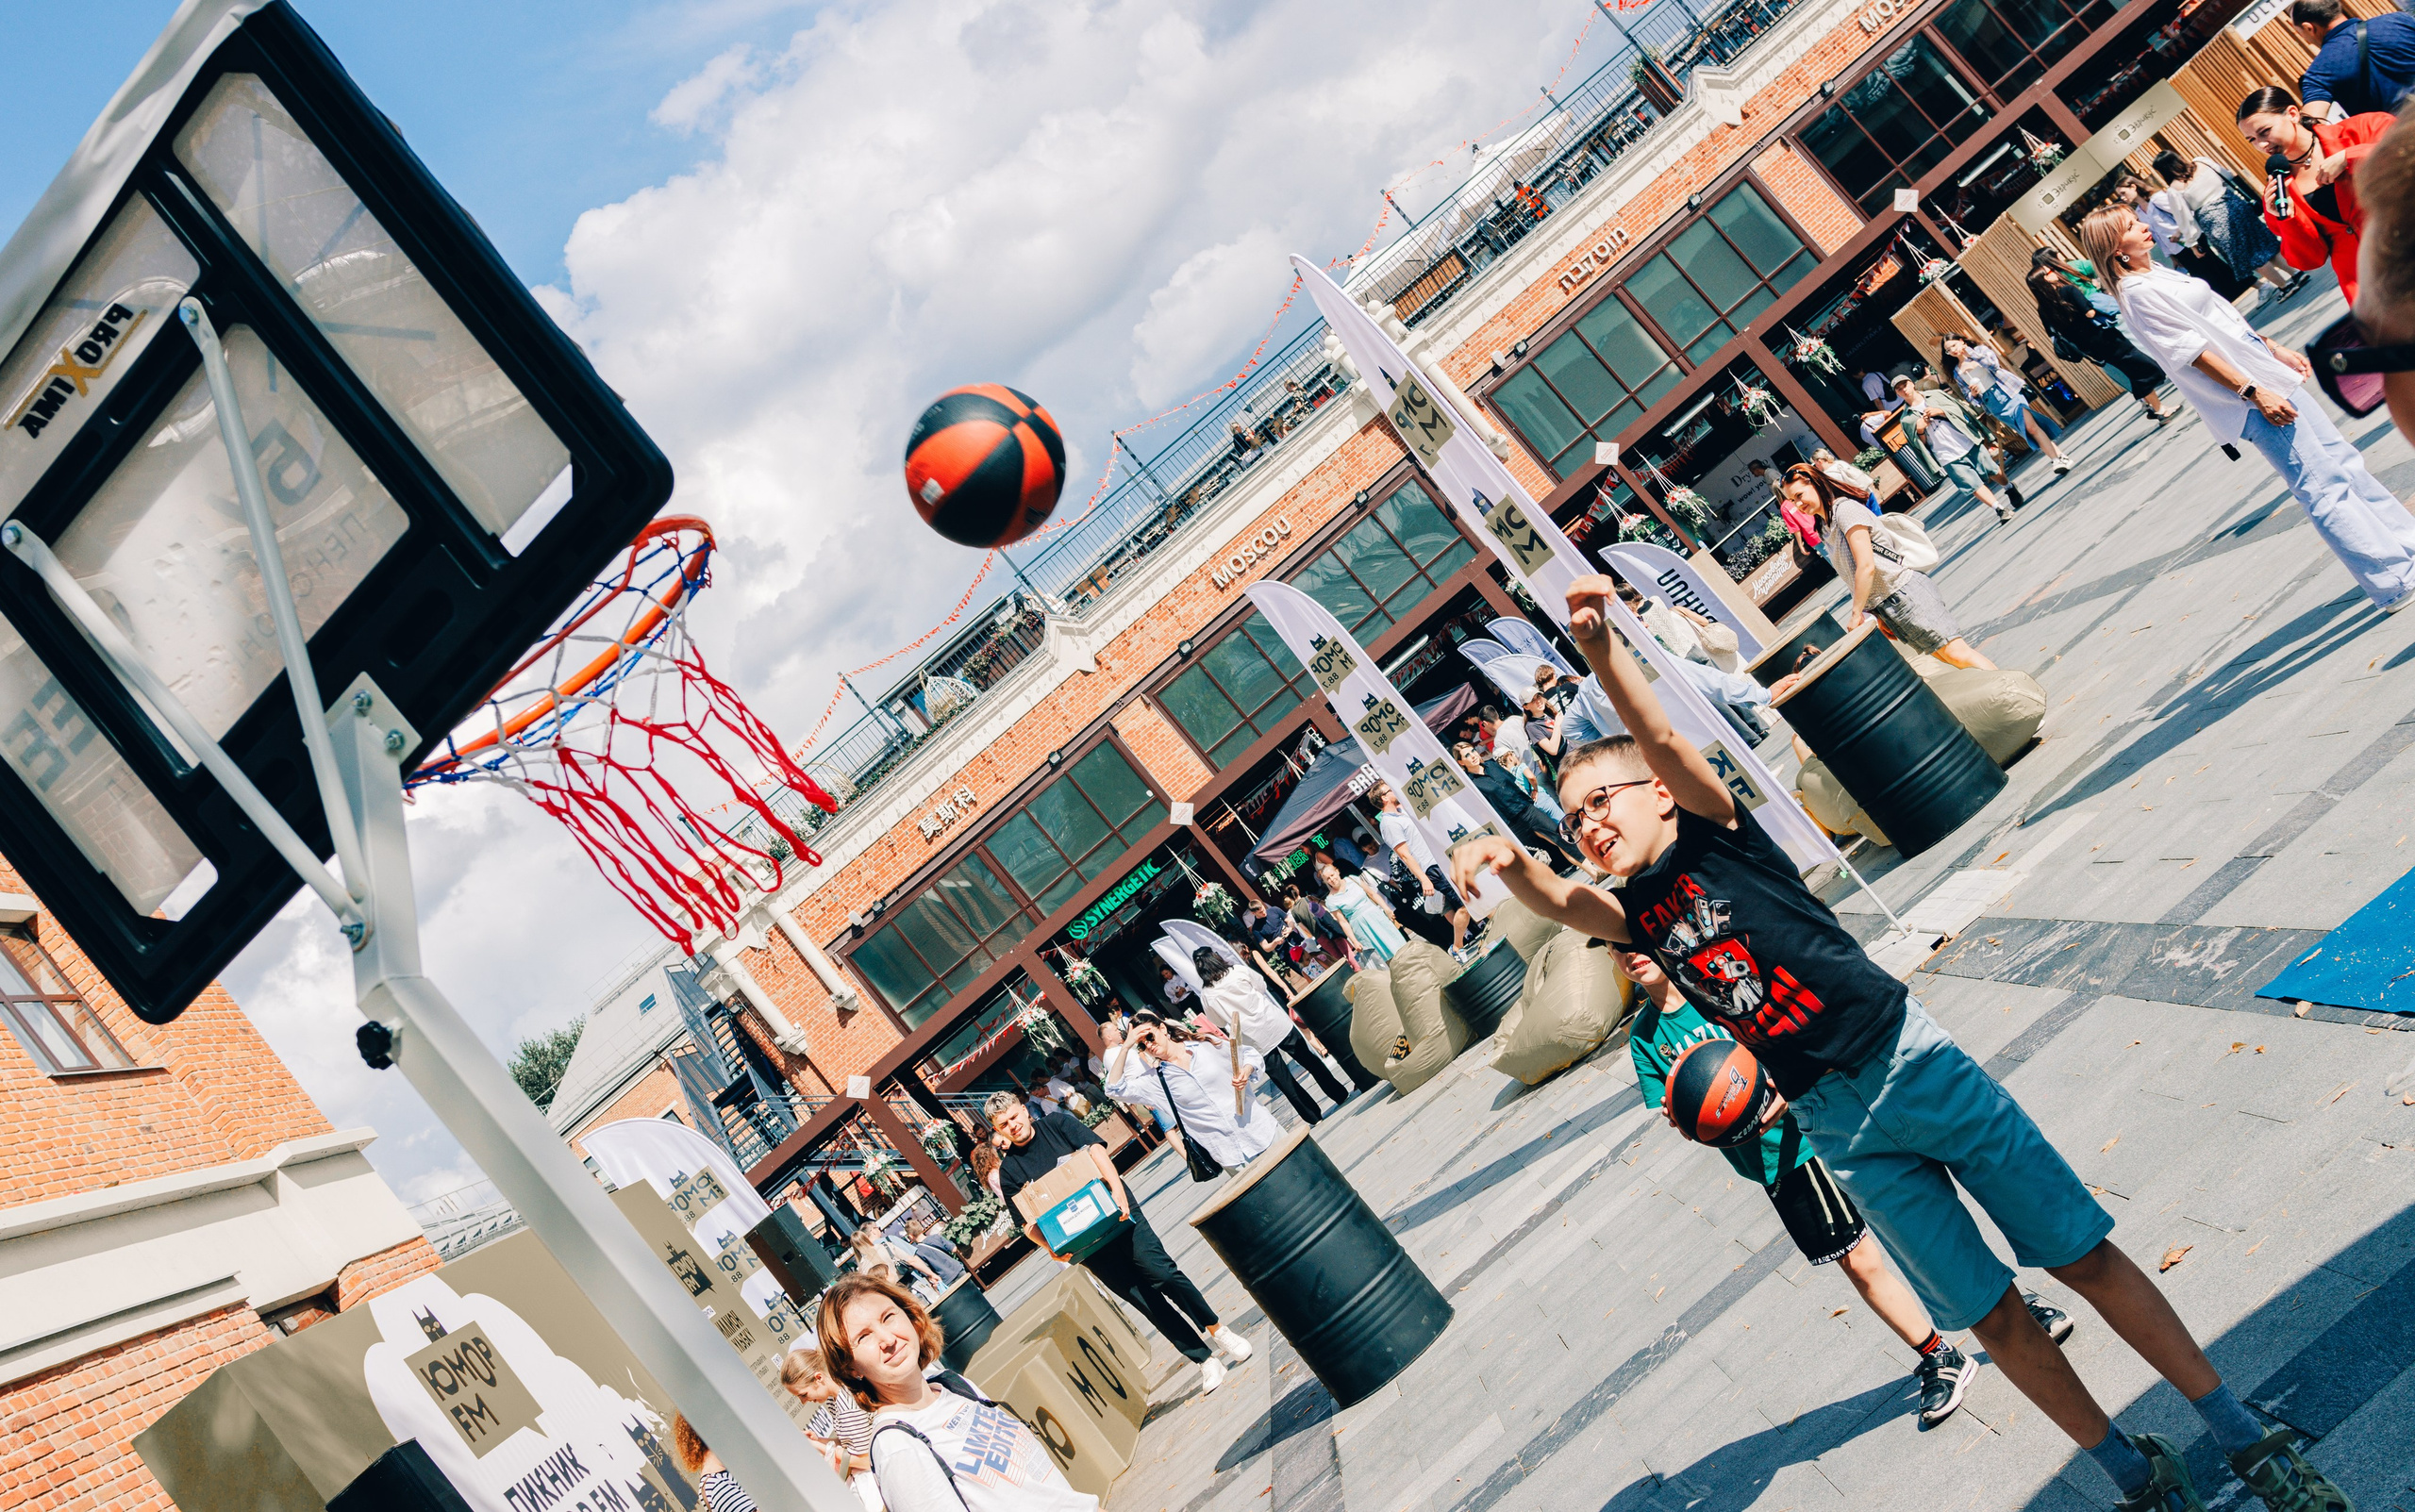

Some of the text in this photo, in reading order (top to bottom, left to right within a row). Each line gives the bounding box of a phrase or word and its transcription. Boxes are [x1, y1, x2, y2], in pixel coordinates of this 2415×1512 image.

[1211, 515, 1292, 589] MOSCOU
[1347, 763, 1380, 797] BRA
[917, 786, 978, 840] 莫斯科
[1084, 858, 1161, 928] SYNERGETIC
[1731, 1088, 1771, 1143] DEMIX
[419, 1336, 497, 1403] ЮМОР
[449, 1392, 501, 1443] FM
